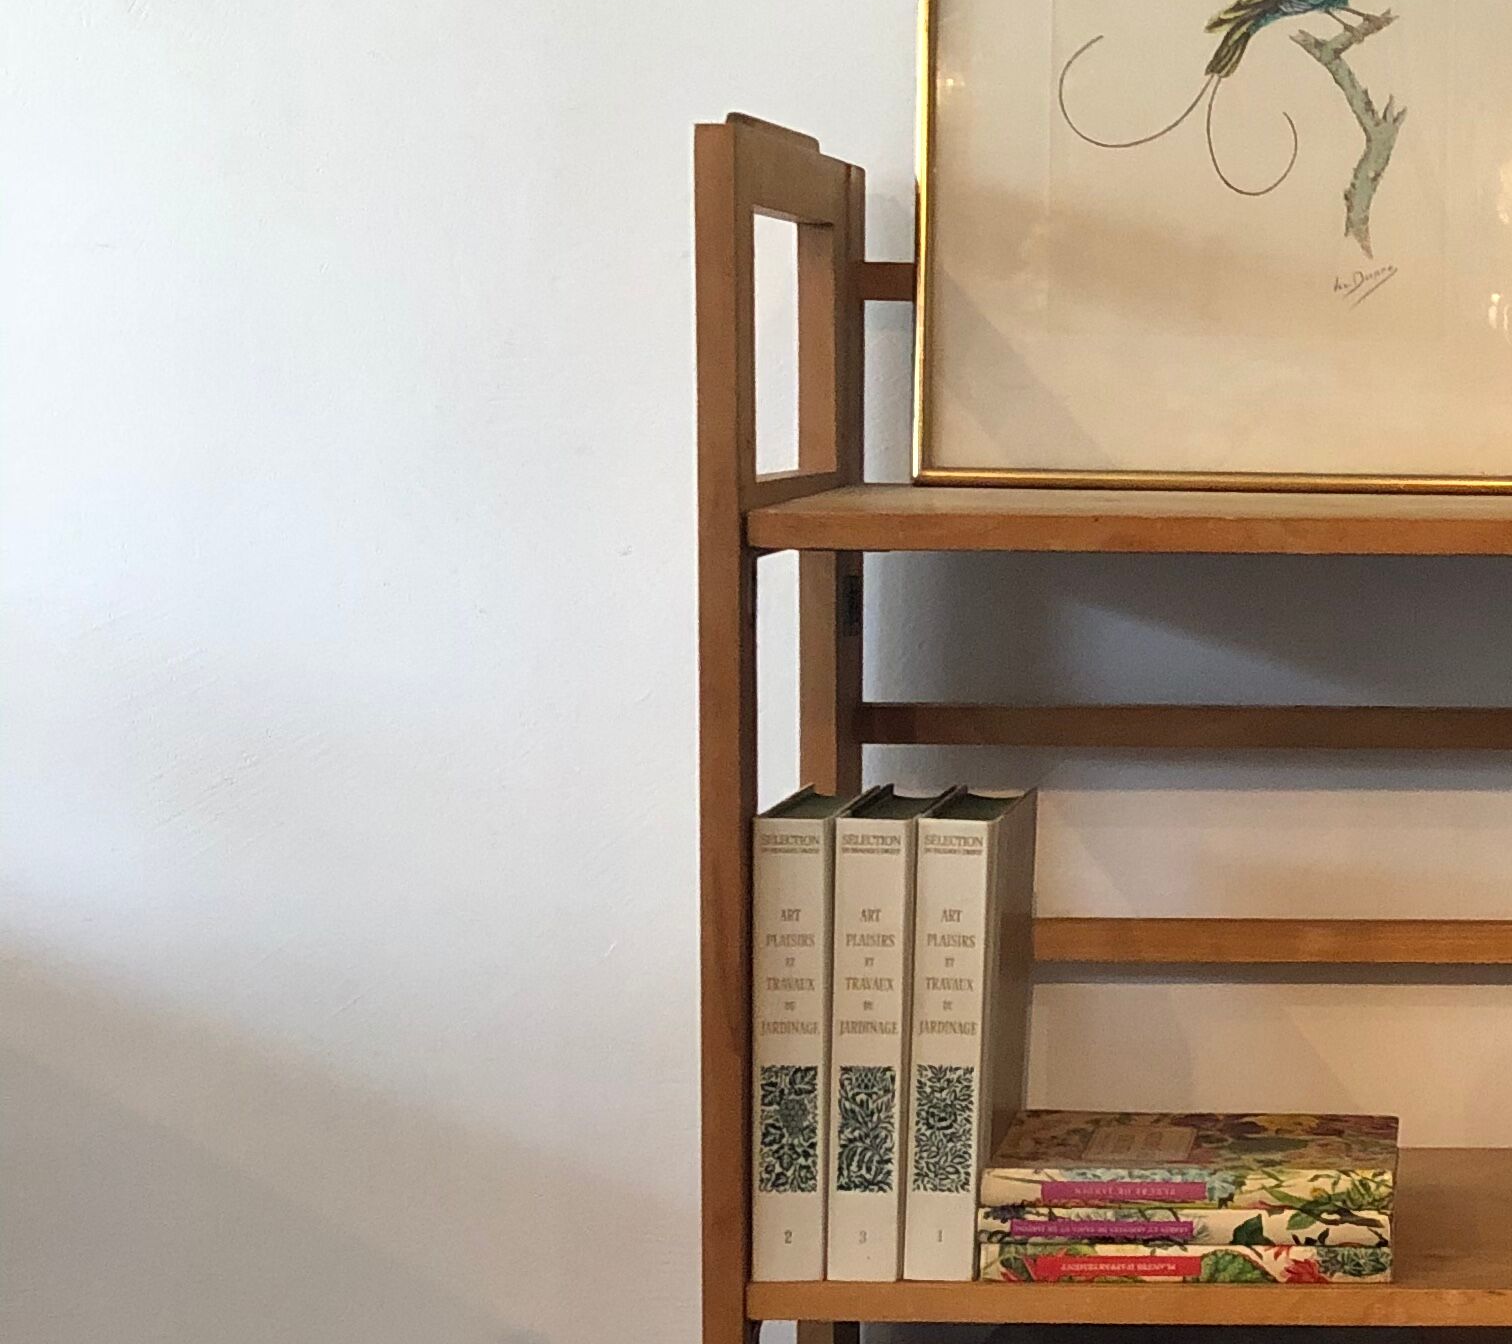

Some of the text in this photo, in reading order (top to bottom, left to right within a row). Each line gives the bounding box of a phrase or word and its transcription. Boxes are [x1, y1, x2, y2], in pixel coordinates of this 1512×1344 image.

[780, 909, 801, 922] ART
[860, 909, 881, 923] ART
[941, 909, 962, 923] ART
[766, 933, 815, 947] PLAISIRS
[846, 933, 895, 948] PLAISIRS
[927, 933, 976, 949] PLAISIRS
[767, 977, 815, 991] TRAVAUX
[845, 977, 894, 992] TRAVAUX
[926, 977, 974, 992] TRAVAUX
[761, 1020, 819, 1036] JARDINAGE
[839, 1020, 898, 1036] JARDINAGE
[919, 1020, 978, 1036] JARDINAGE
[784, 1230, 793, 1244] 2
[858, 1230, 868, 1244] 3
[937, 1229, 943, 1243] 1
